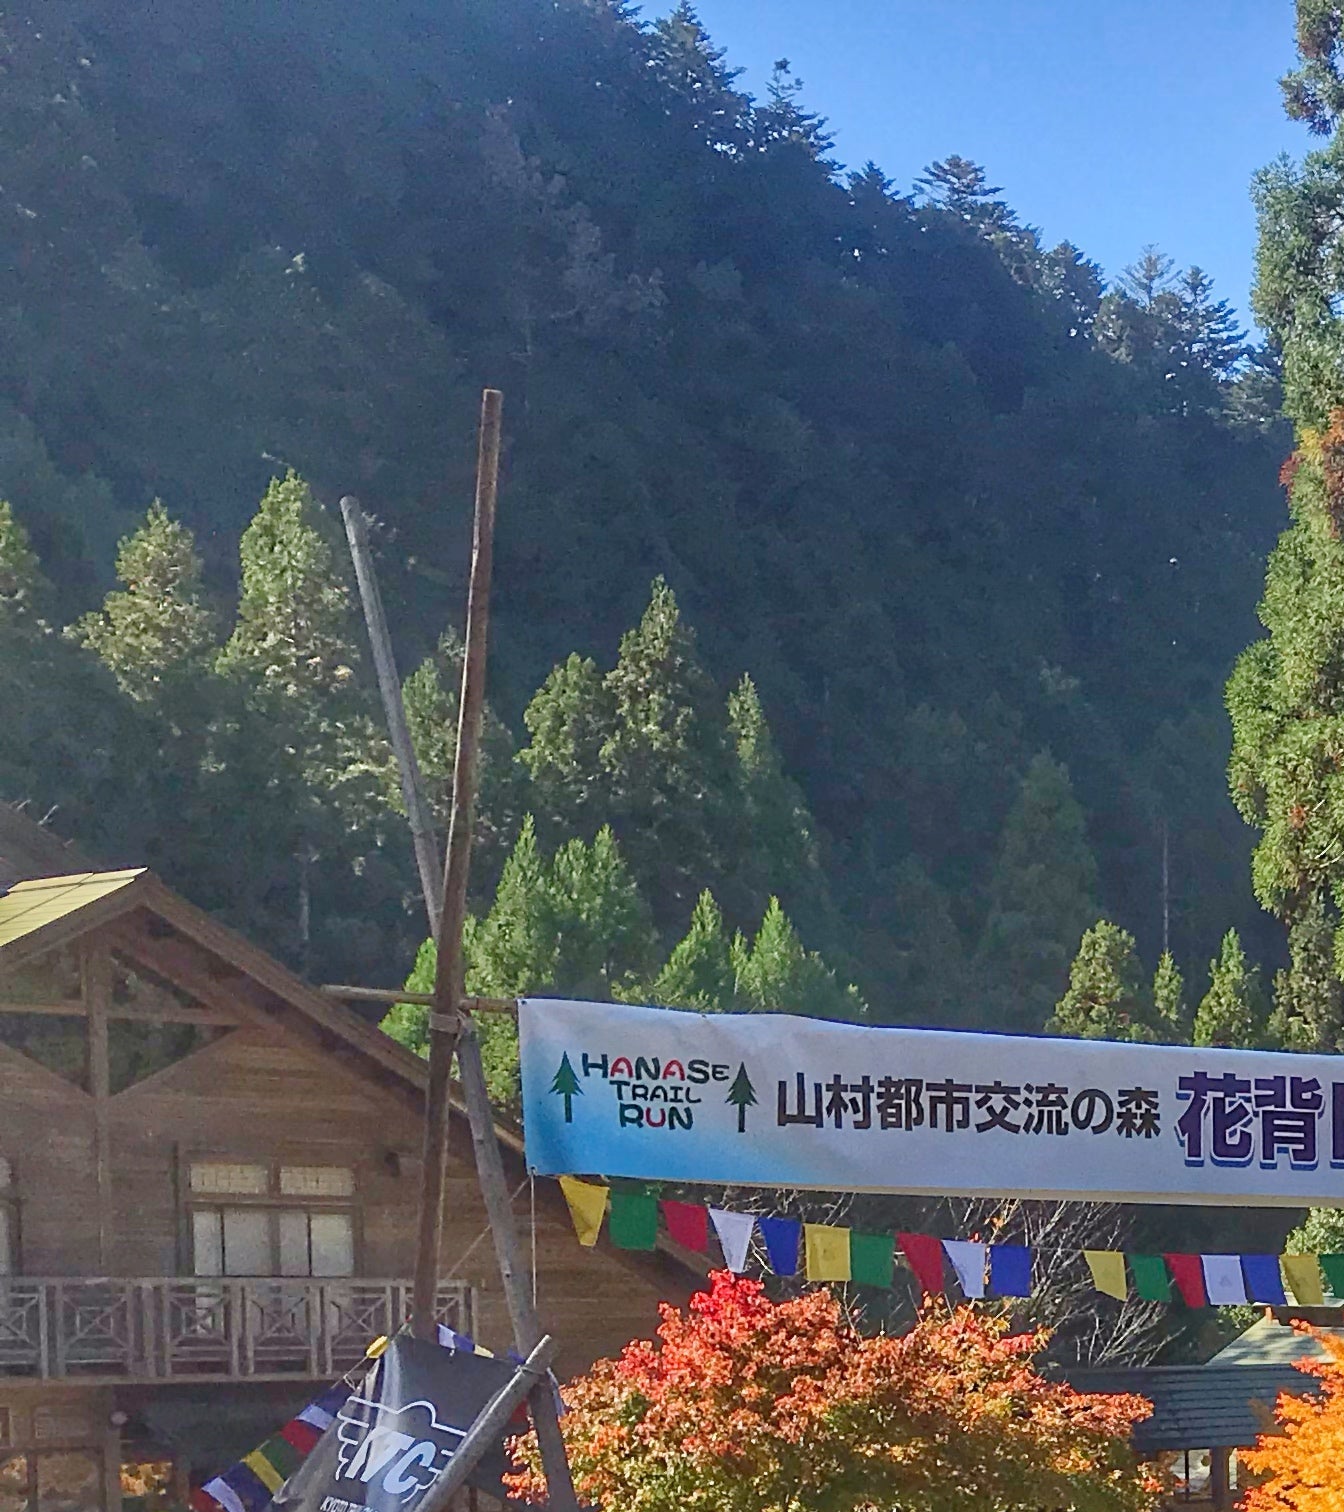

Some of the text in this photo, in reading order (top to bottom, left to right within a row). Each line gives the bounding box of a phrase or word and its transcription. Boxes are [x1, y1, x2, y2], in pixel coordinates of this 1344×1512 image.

[582, 1053, 730, 1084] HANASE
[609, 1080, 702, 1103] TRAIL
[777, 1072, 1161, 1139] 山村都市交流の森
[619, 1102, 694, 1130] RUN
